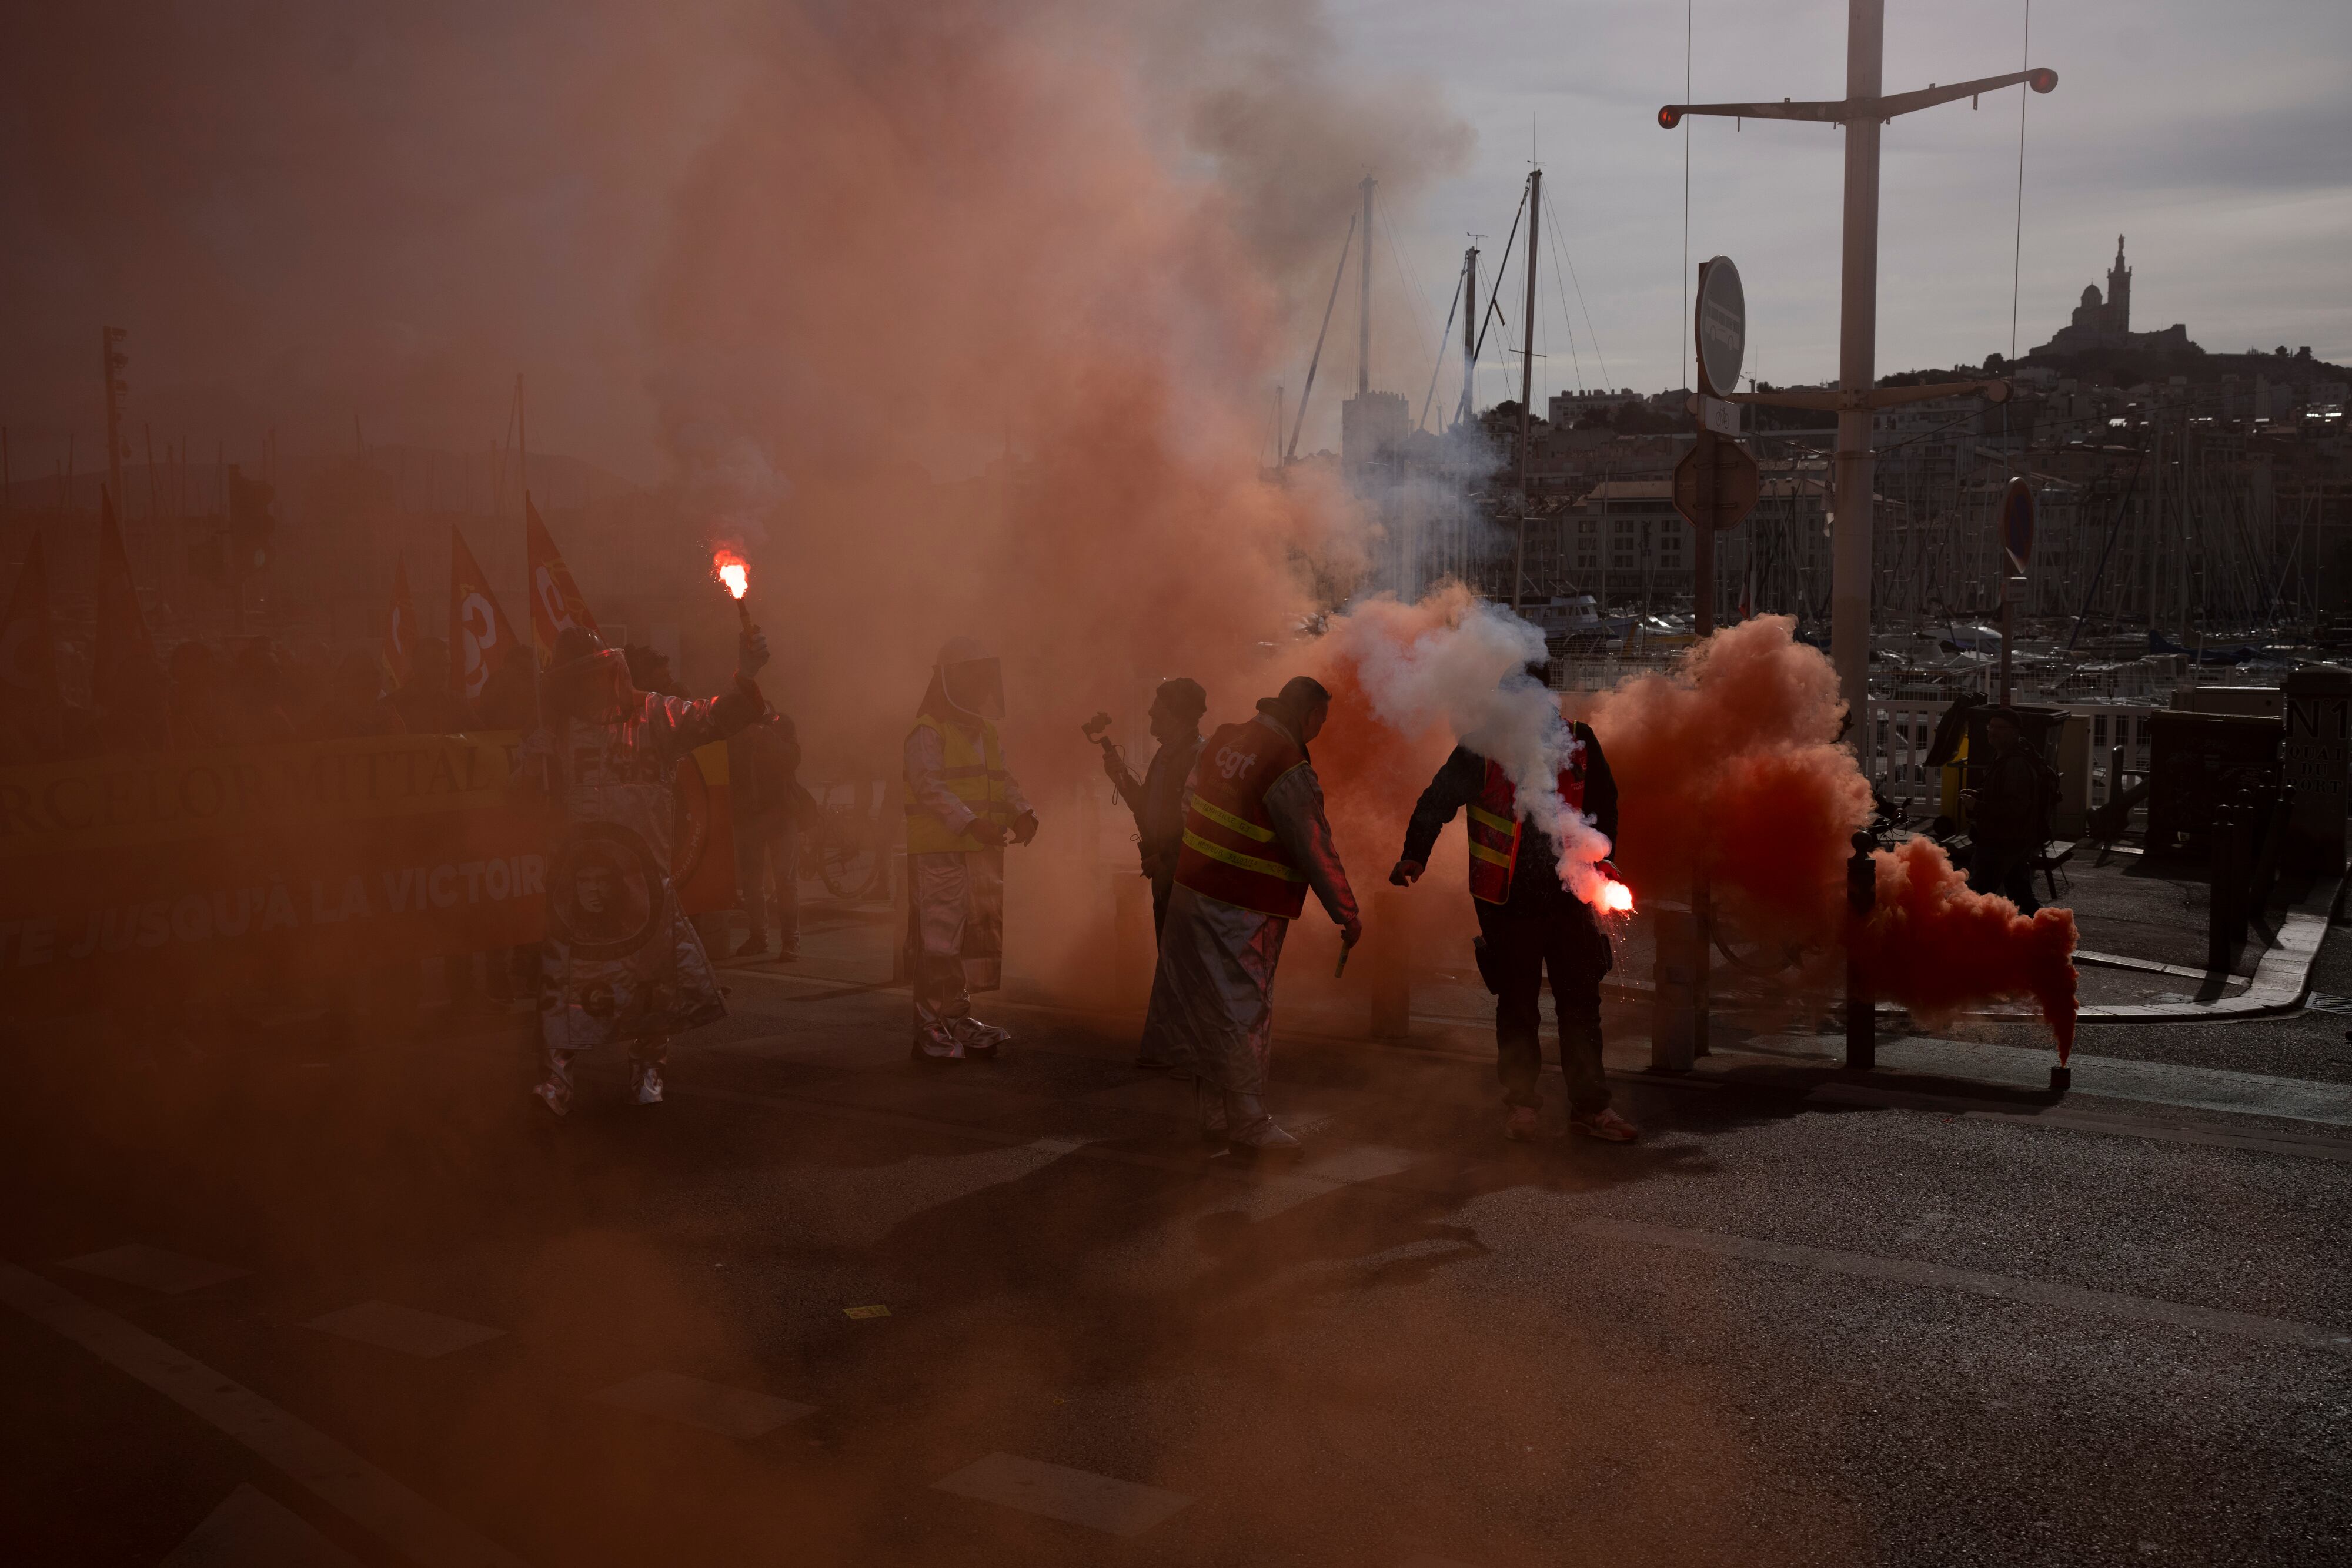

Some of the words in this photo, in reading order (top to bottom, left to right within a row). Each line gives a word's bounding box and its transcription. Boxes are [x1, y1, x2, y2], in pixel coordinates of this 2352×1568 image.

[1215, 747, 1257, 780] cgt
[2290, 744, 2343, 761] QUAI
[2301, 762, 2328, 776] DU
[671, 820, 701, 882] os-sur-Mer
[311, 874, 372, 925] LA
[380, 854, 547, 914] VICTOIR
